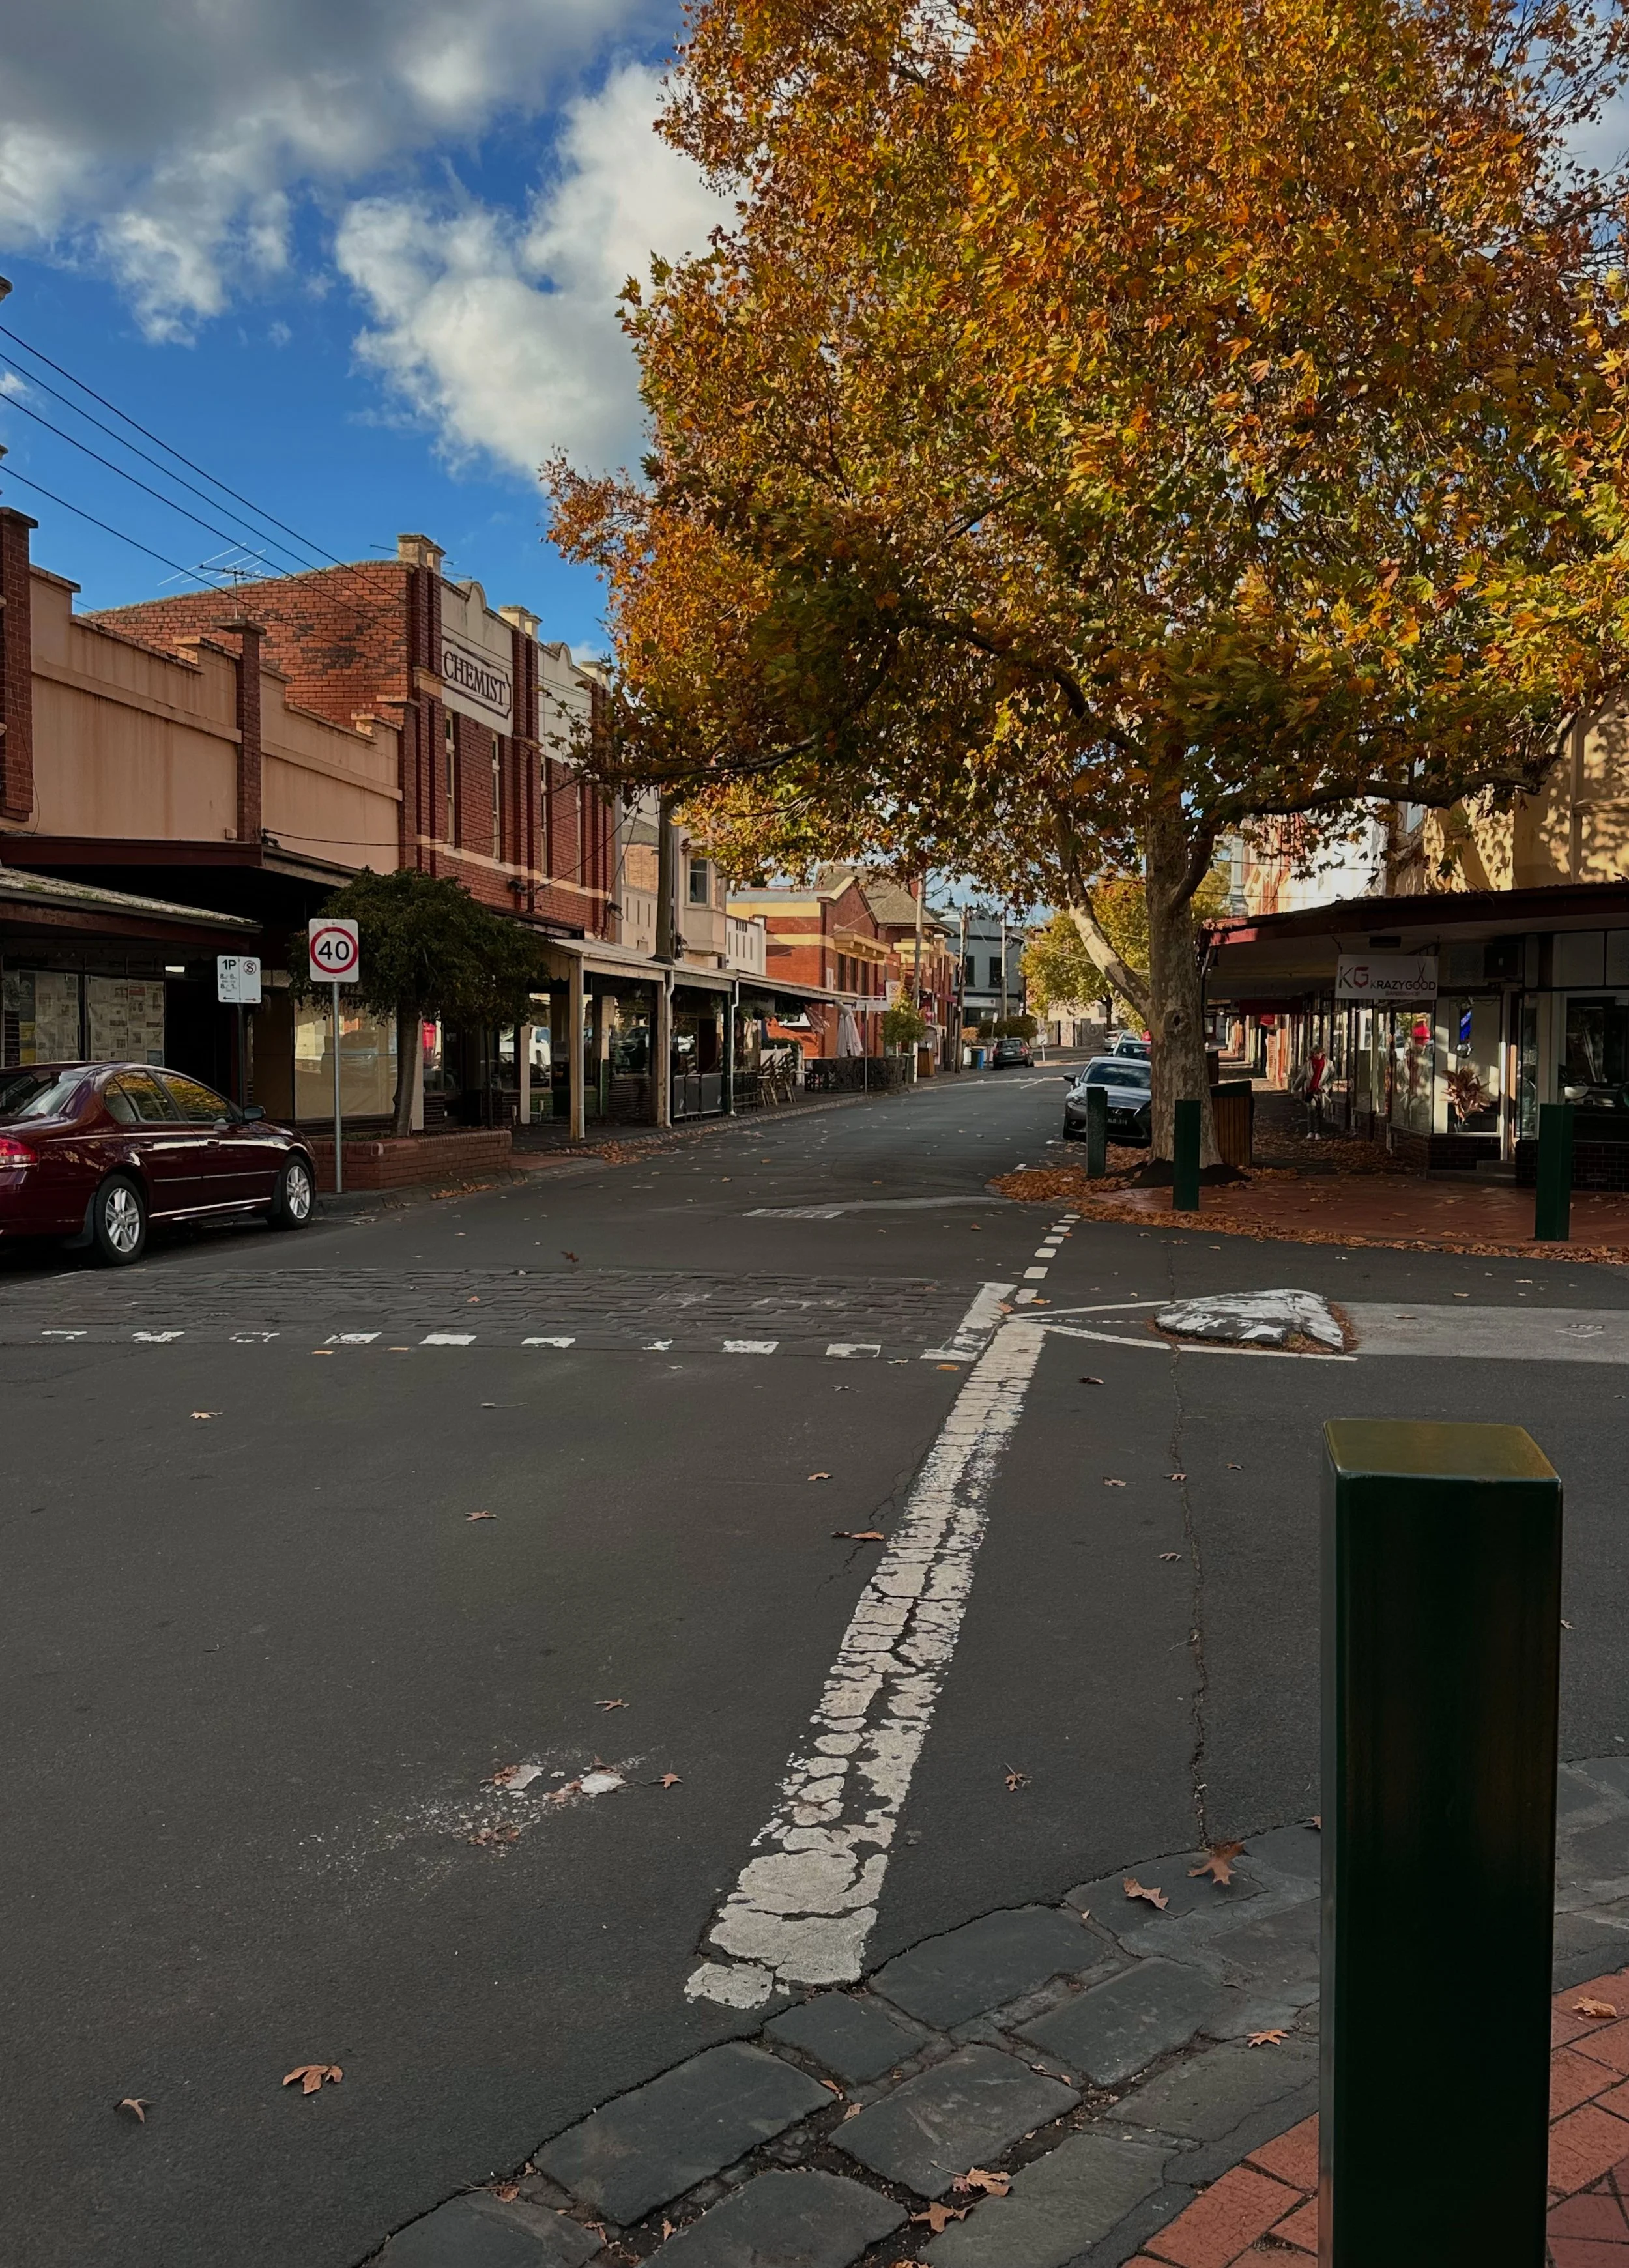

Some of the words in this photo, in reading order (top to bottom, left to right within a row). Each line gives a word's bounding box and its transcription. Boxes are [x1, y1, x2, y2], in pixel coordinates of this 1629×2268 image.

[444, 650, 506, 706] CHEMIST
[317, 940, 349, 961] 40
[222, 959, 237, 971] 1P
[1338, 966, 1369, 988] KG
[1370, 979, 1436, 990] KRAZYGOOD
